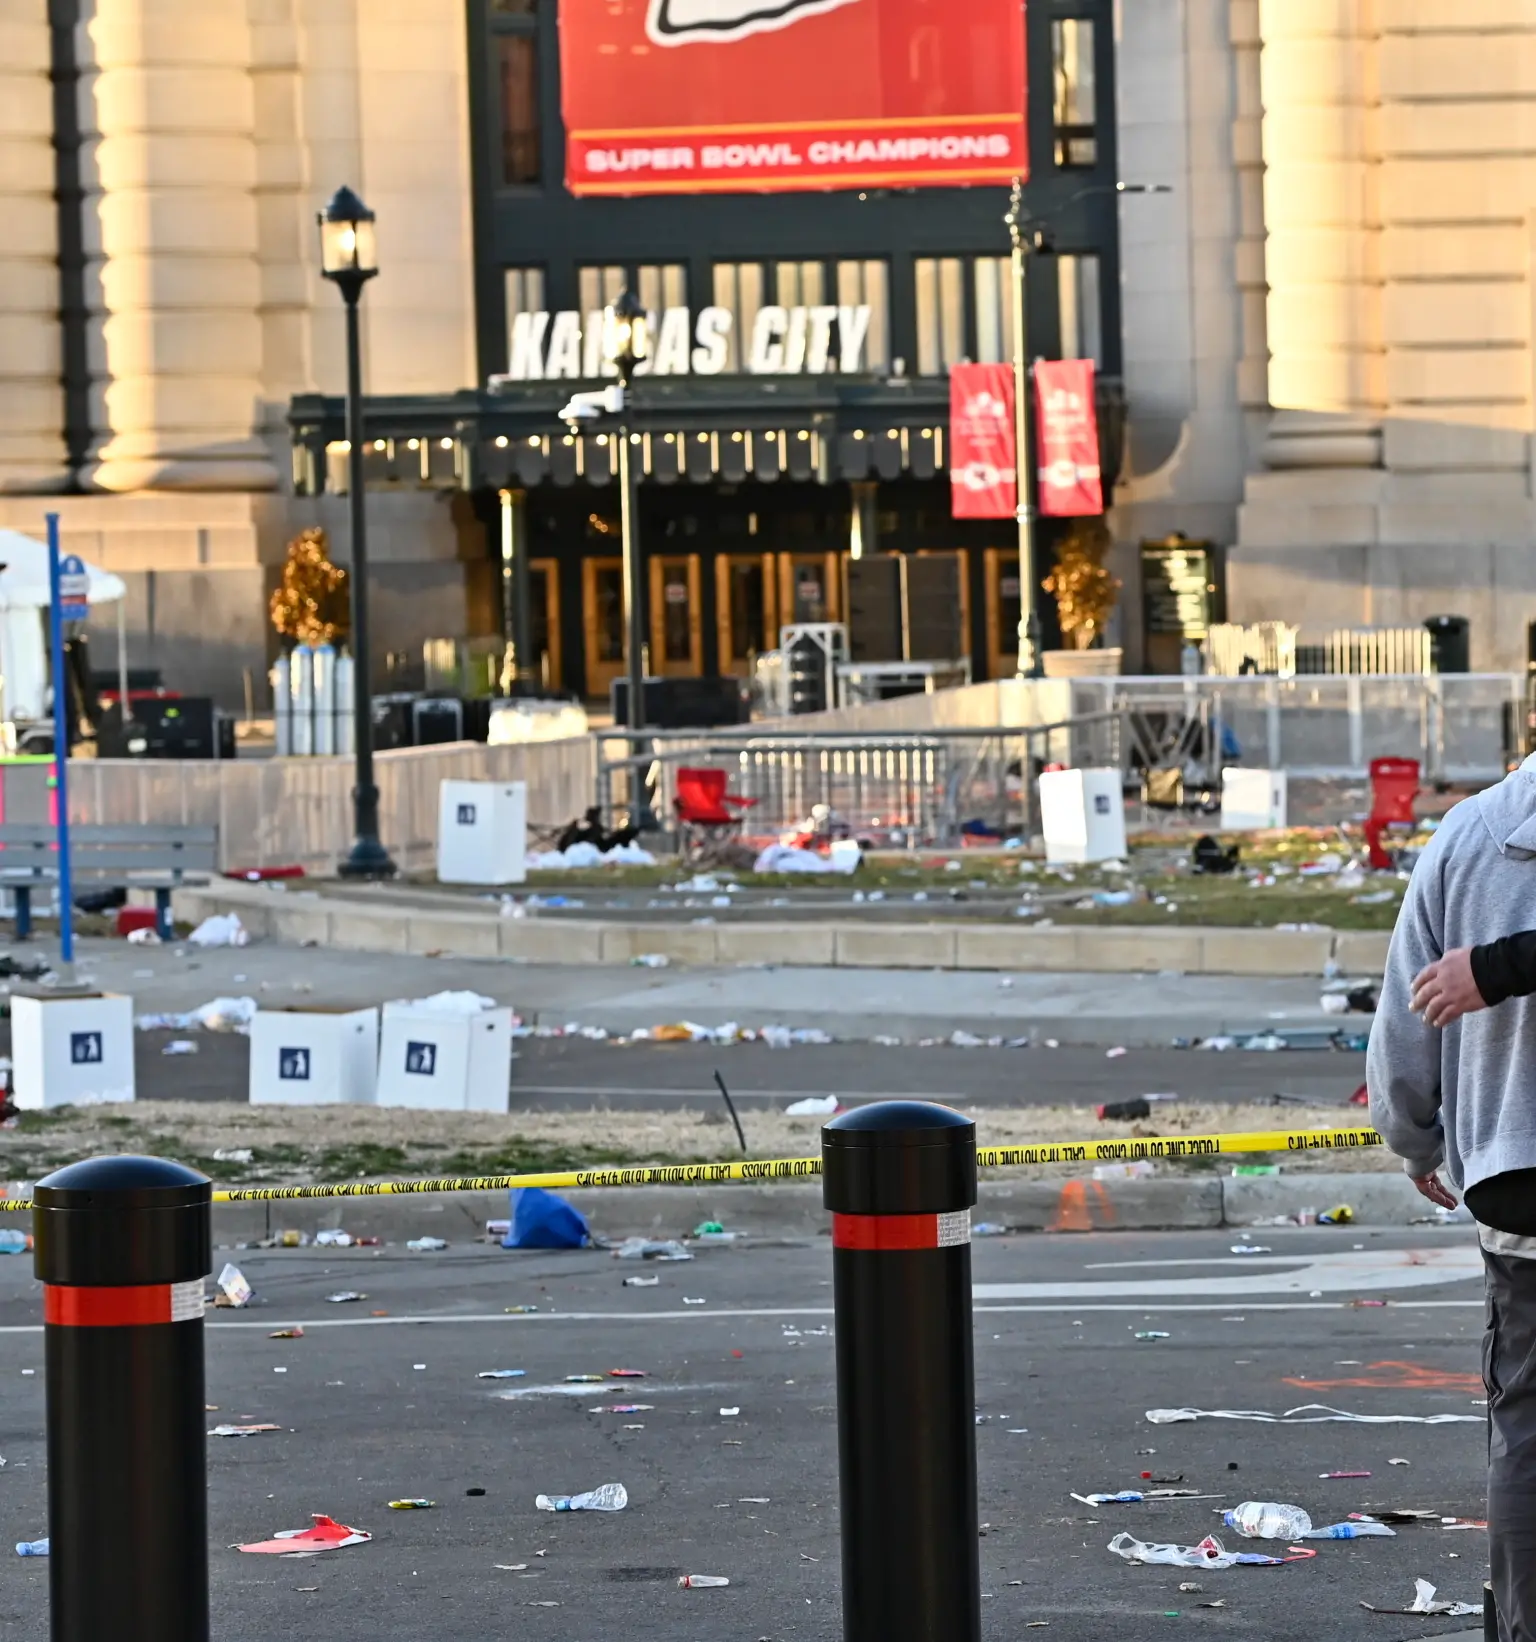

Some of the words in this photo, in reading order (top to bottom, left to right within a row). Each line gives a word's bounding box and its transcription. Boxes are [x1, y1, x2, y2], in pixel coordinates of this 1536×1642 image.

[585, 147, 695, 172] SUPER
[700, 142, 802, 169] BOWL
[808, 133, 1011, 164] CHAMPIONS
[749, 304, 873, 374] CITY
